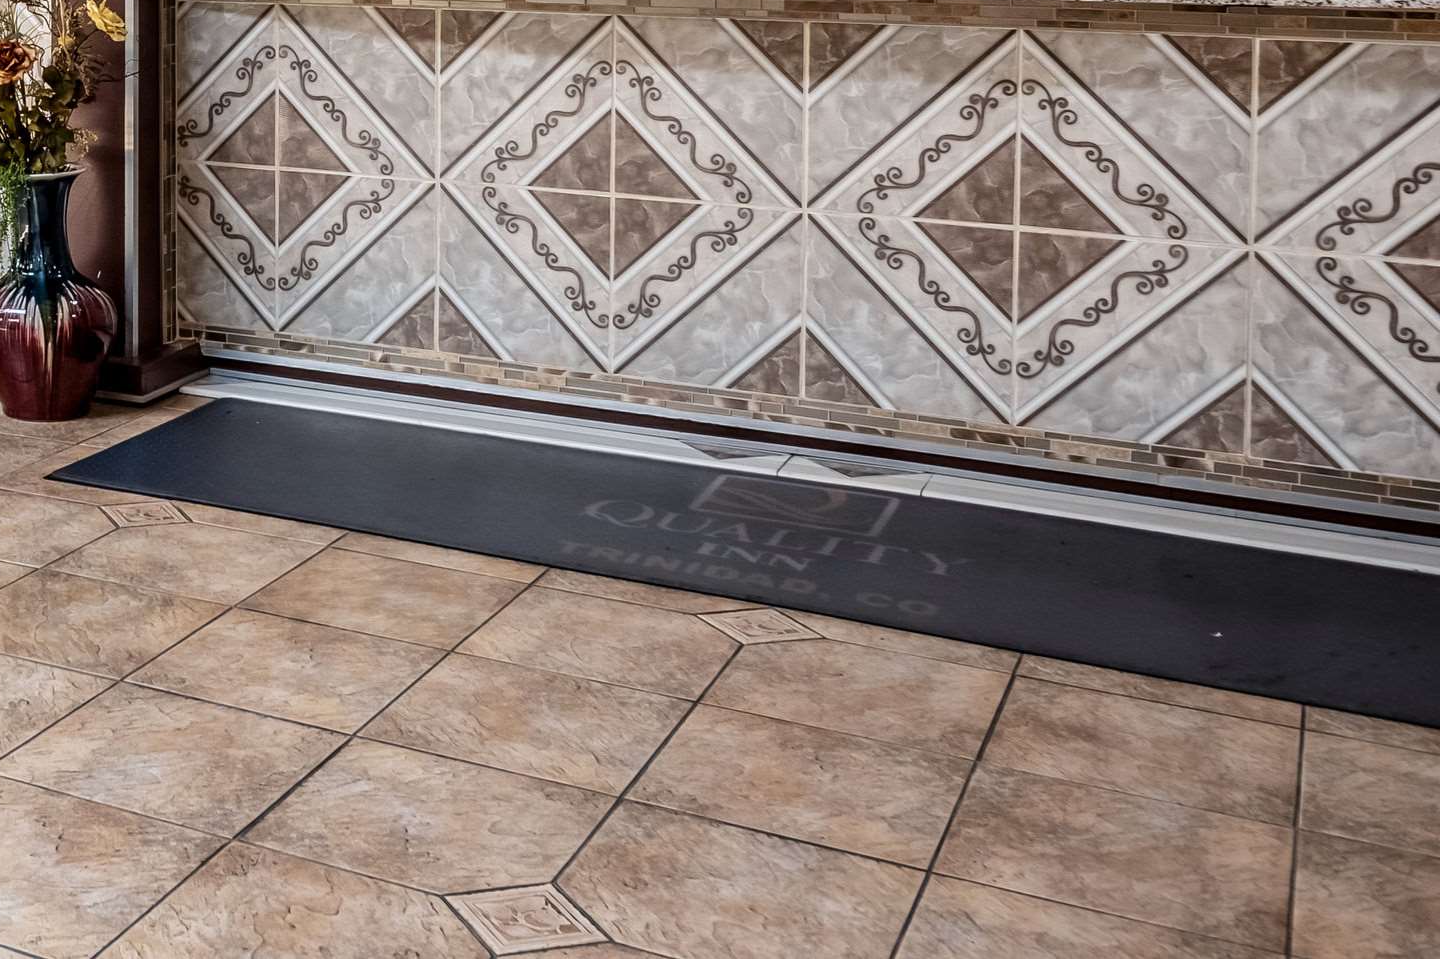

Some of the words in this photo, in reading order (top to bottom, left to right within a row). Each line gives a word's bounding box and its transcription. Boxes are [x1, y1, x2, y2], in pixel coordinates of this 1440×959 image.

[582, 499, 970, 576] QUALITY
[696, 542, 812, 572] INN
[857, 591, 941, 617] CO
